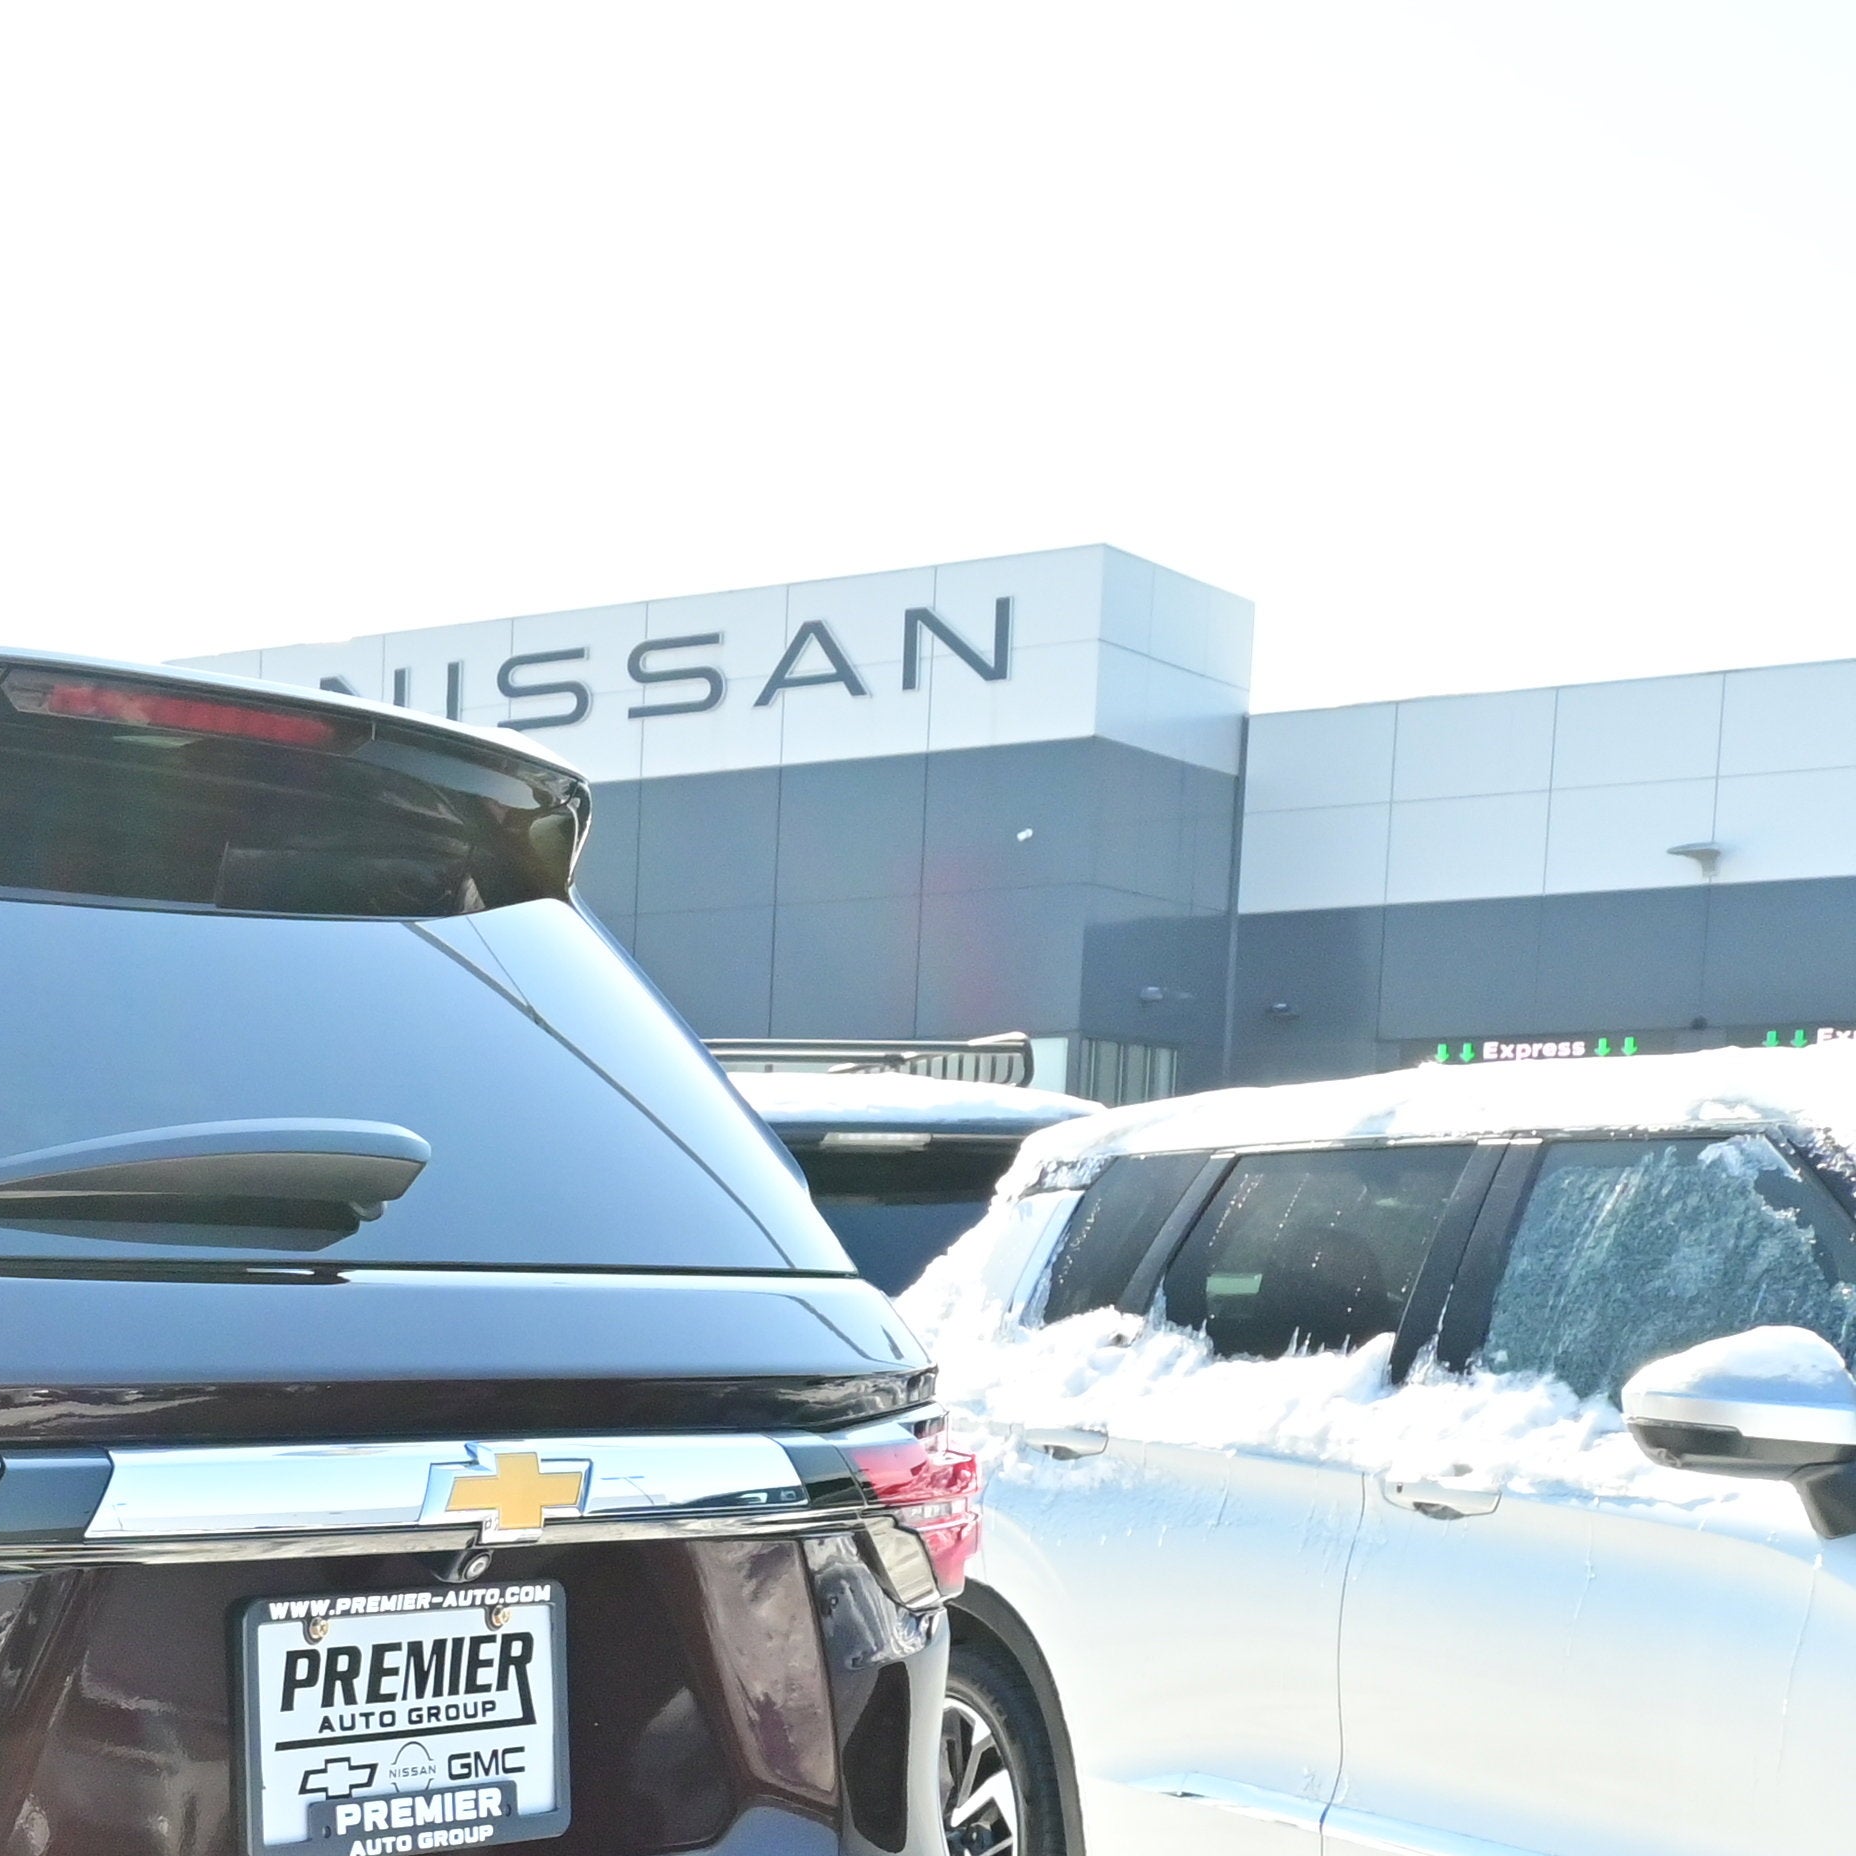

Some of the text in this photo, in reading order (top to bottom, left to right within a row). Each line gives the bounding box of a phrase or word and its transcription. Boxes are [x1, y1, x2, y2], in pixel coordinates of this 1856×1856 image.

[1483, 1040, 1585, 1061] Express
[269, 1584, 551, 1620] WWW.PREMIER-AUTO.COM
[280, 1631, 536, 1714] PREMIER
[318, 1700, 497, 1733] AUTO GROUP
[389, 1764, 437, 1779] NISSAN
[447, 1746, 526, 1780] GMC
[335, 1787, 503, 1835] PREMIER
[417, 1824, 494, 1849] GROUP
